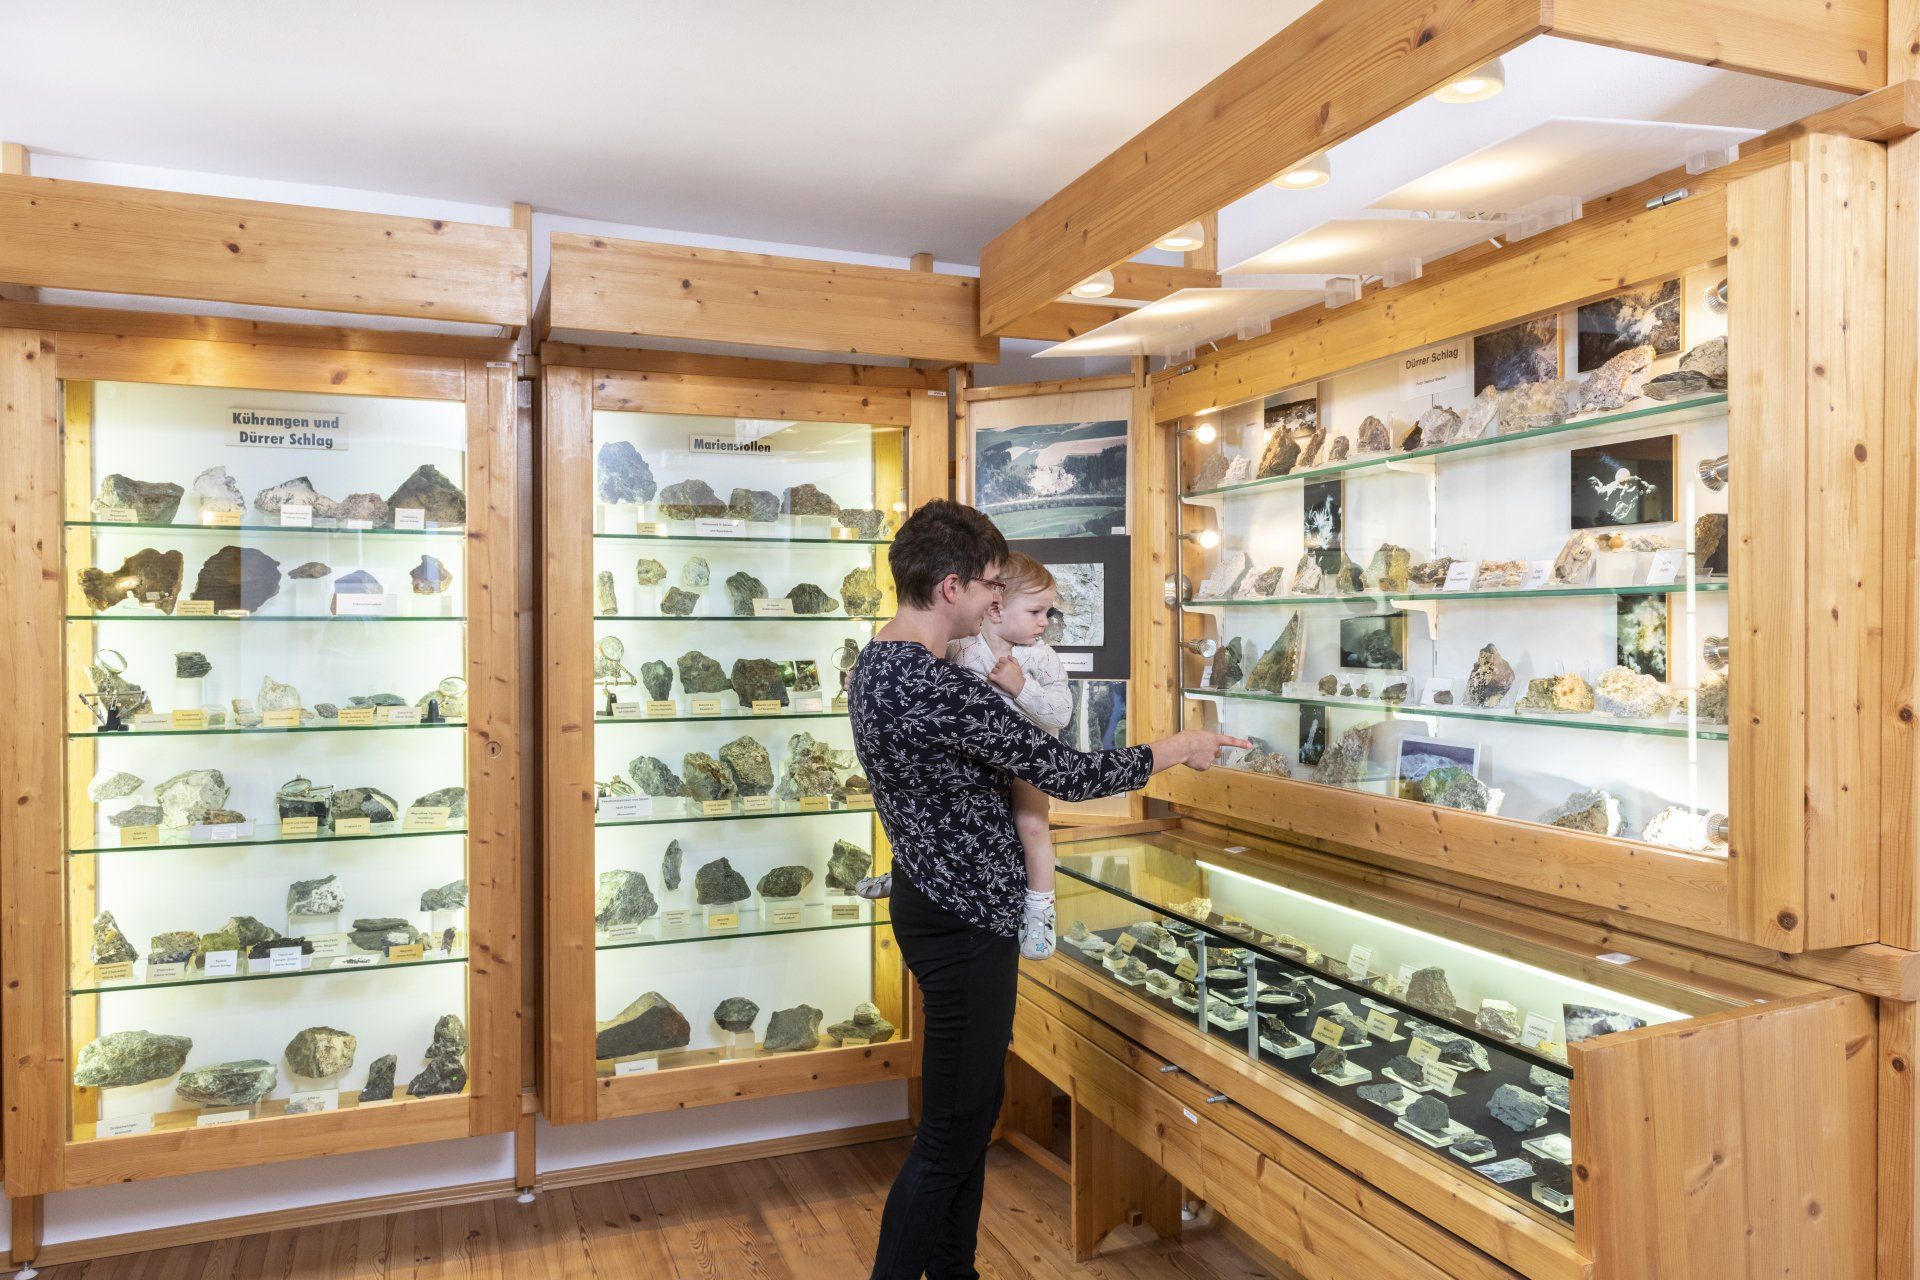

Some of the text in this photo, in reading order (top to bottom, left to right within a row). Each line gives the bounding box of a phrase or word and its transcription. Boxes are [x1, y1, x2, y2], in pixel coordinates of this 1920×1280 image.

[1405, 348, 1459, 370] Dürrer Schlag
[232, 412, 340, 429] Kührangen und
[239, 431, 334, 449] Dürrer Schlag
[694, 438, 771, 453] Marienstollen
